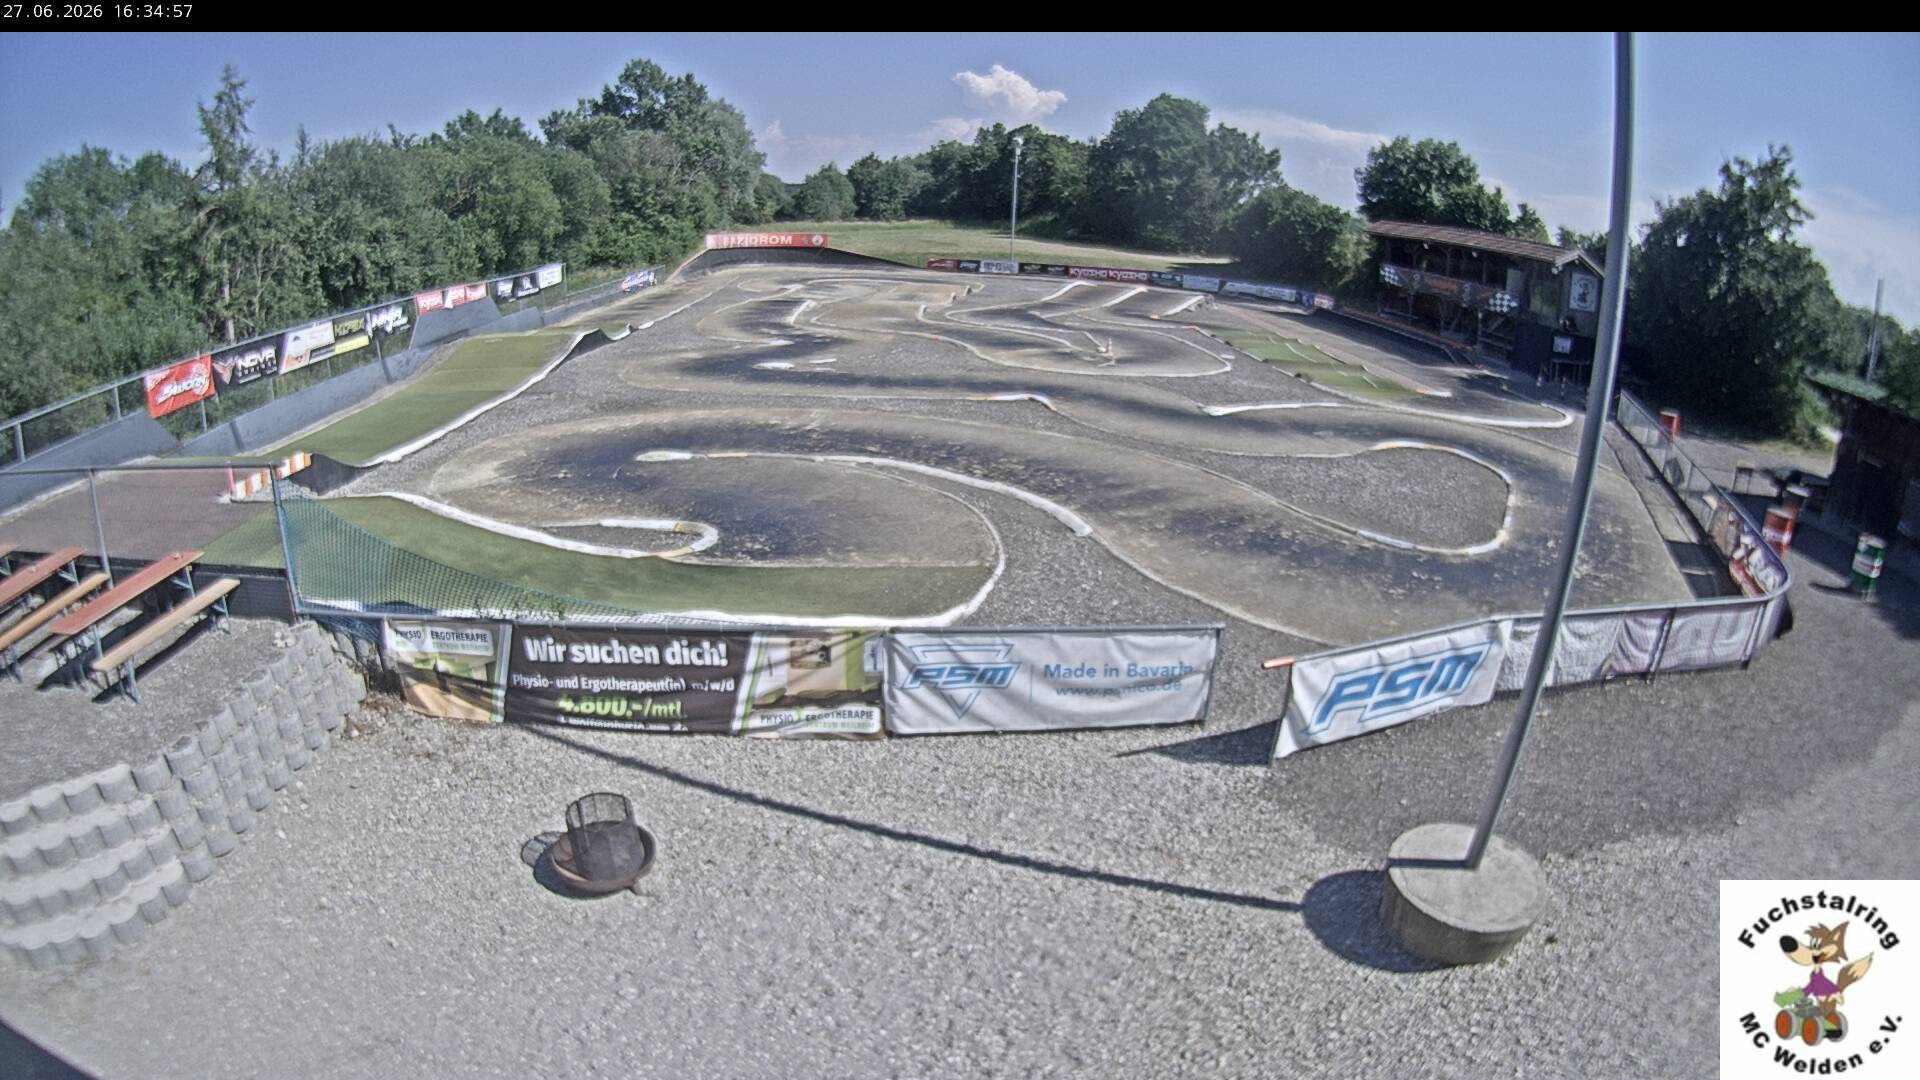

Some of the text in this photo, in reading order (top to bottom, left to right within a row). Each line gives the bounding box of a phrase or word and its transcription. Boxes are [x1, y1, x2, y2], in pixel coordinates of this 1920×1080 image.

[430, 630, 489, 643] ERGOTHERAPIE
[524, 636, 728, 667] Wir suchen dich!
[911, 665, 1013, 687] PSM
[1043, 662, 1097, 679] Made
[1104, 664, 1120, 678] in
[513, 674, 553, 690] Physio-
[556, 675, 578, 689] und
[581, 676, 686, 694] Ergotherapeut(in)
[1313, 650, 1485, 725] PSM
[760, 713, 794, 725] PHYSIO
[805, 710, 874, 722] ERGOTHERAPIE
